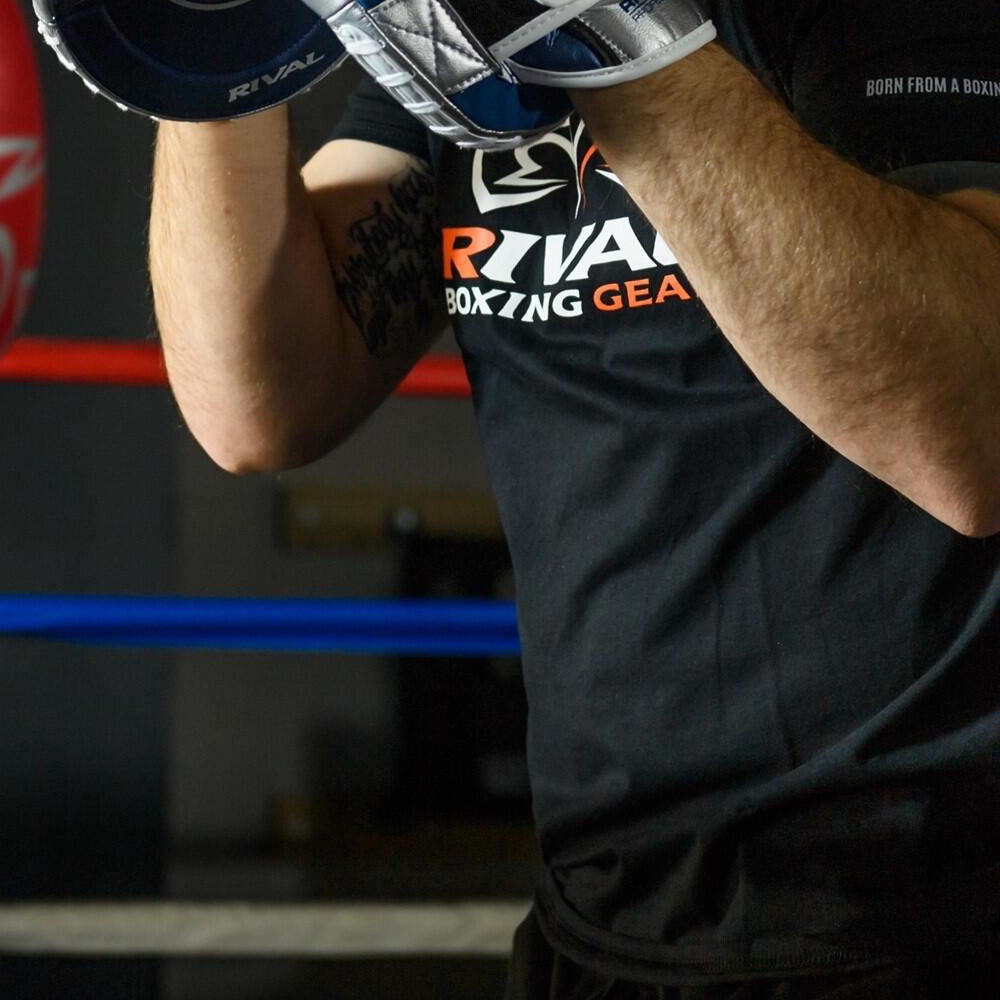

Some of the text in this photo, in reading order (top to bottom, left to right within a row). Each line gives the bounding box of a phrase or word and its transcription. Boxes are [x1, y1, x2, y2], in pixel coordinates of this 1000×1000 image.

[228, 52, 325, 103] RIVAL
[866, 77, 903, 97] BORN
[907, 76, 947, 93] FROM
[950, 77, 960, 93] A
[445, 274, 699, 323] BOXING GEA
